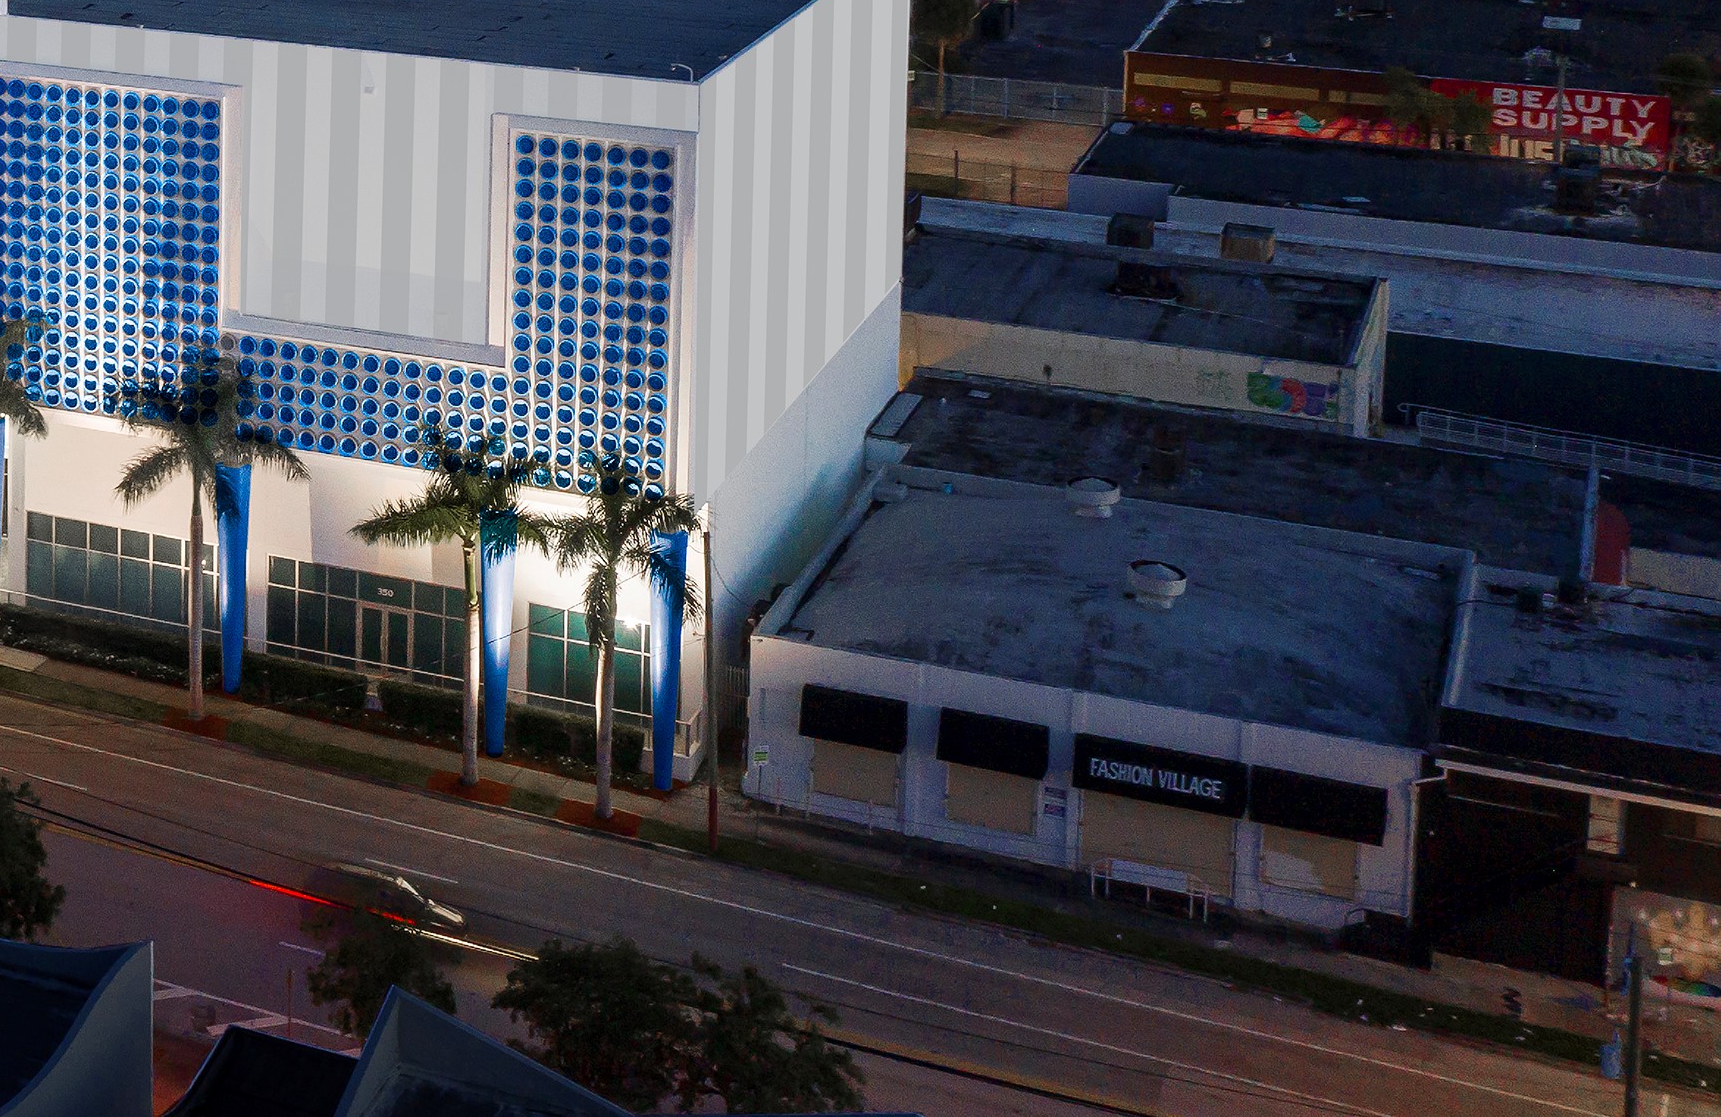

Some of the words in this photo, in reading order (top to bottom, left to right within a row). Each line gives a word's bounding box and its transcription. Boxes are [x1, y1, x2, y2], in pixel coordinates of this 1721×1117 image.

[1492, 87, 1657, 119] BEAUTY
[1492, 108, 1656, 139] SUPPLY
[377, 587, 395, 598] 350
[1090, 757, 1153, 787] FASHION
[1158, 770, 1223, 799] VILLAGE
